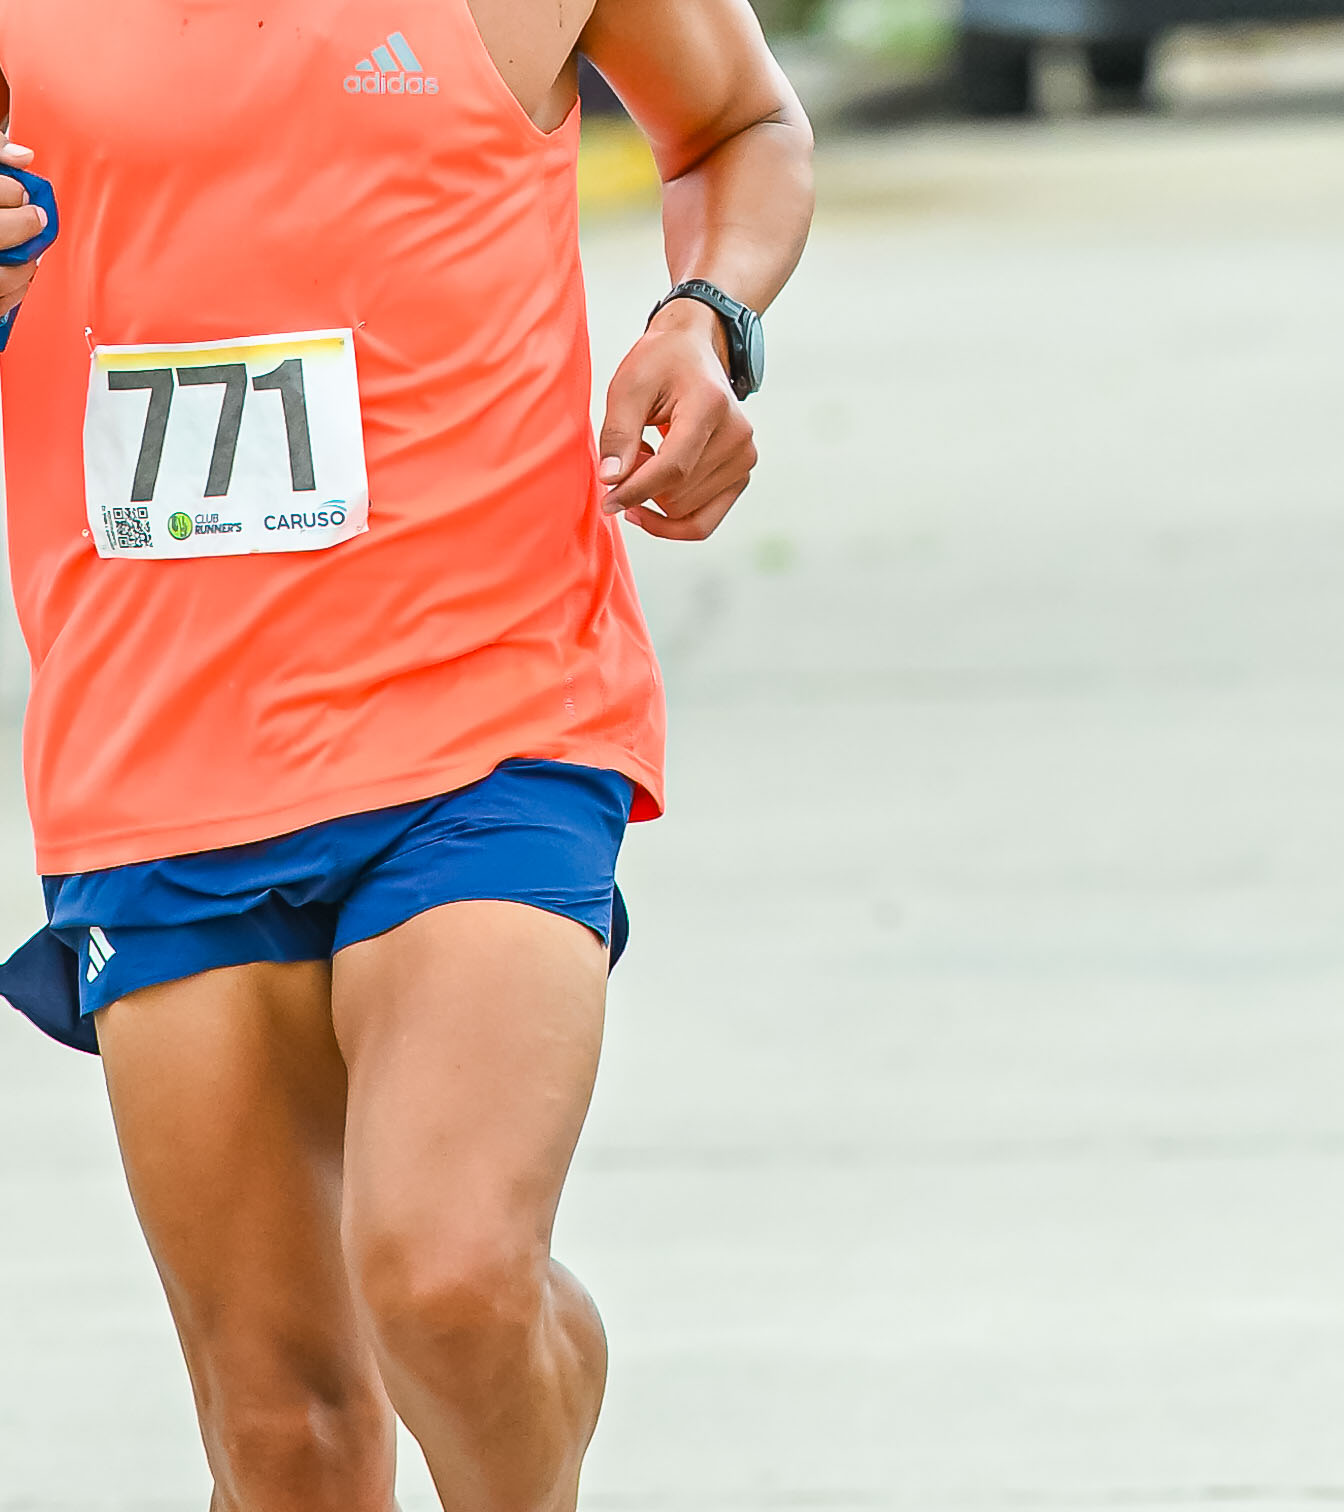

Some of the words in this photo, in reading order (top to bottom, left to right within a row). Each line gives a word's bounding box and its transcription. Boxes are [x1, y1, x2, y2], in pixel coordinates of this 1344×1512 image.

[343, 71, 439, 94] adidas
[107, 358, 316, 502] 771
[194, 513, 219, 524] CLUB
[263, 510, 346, 531] CARUSO
